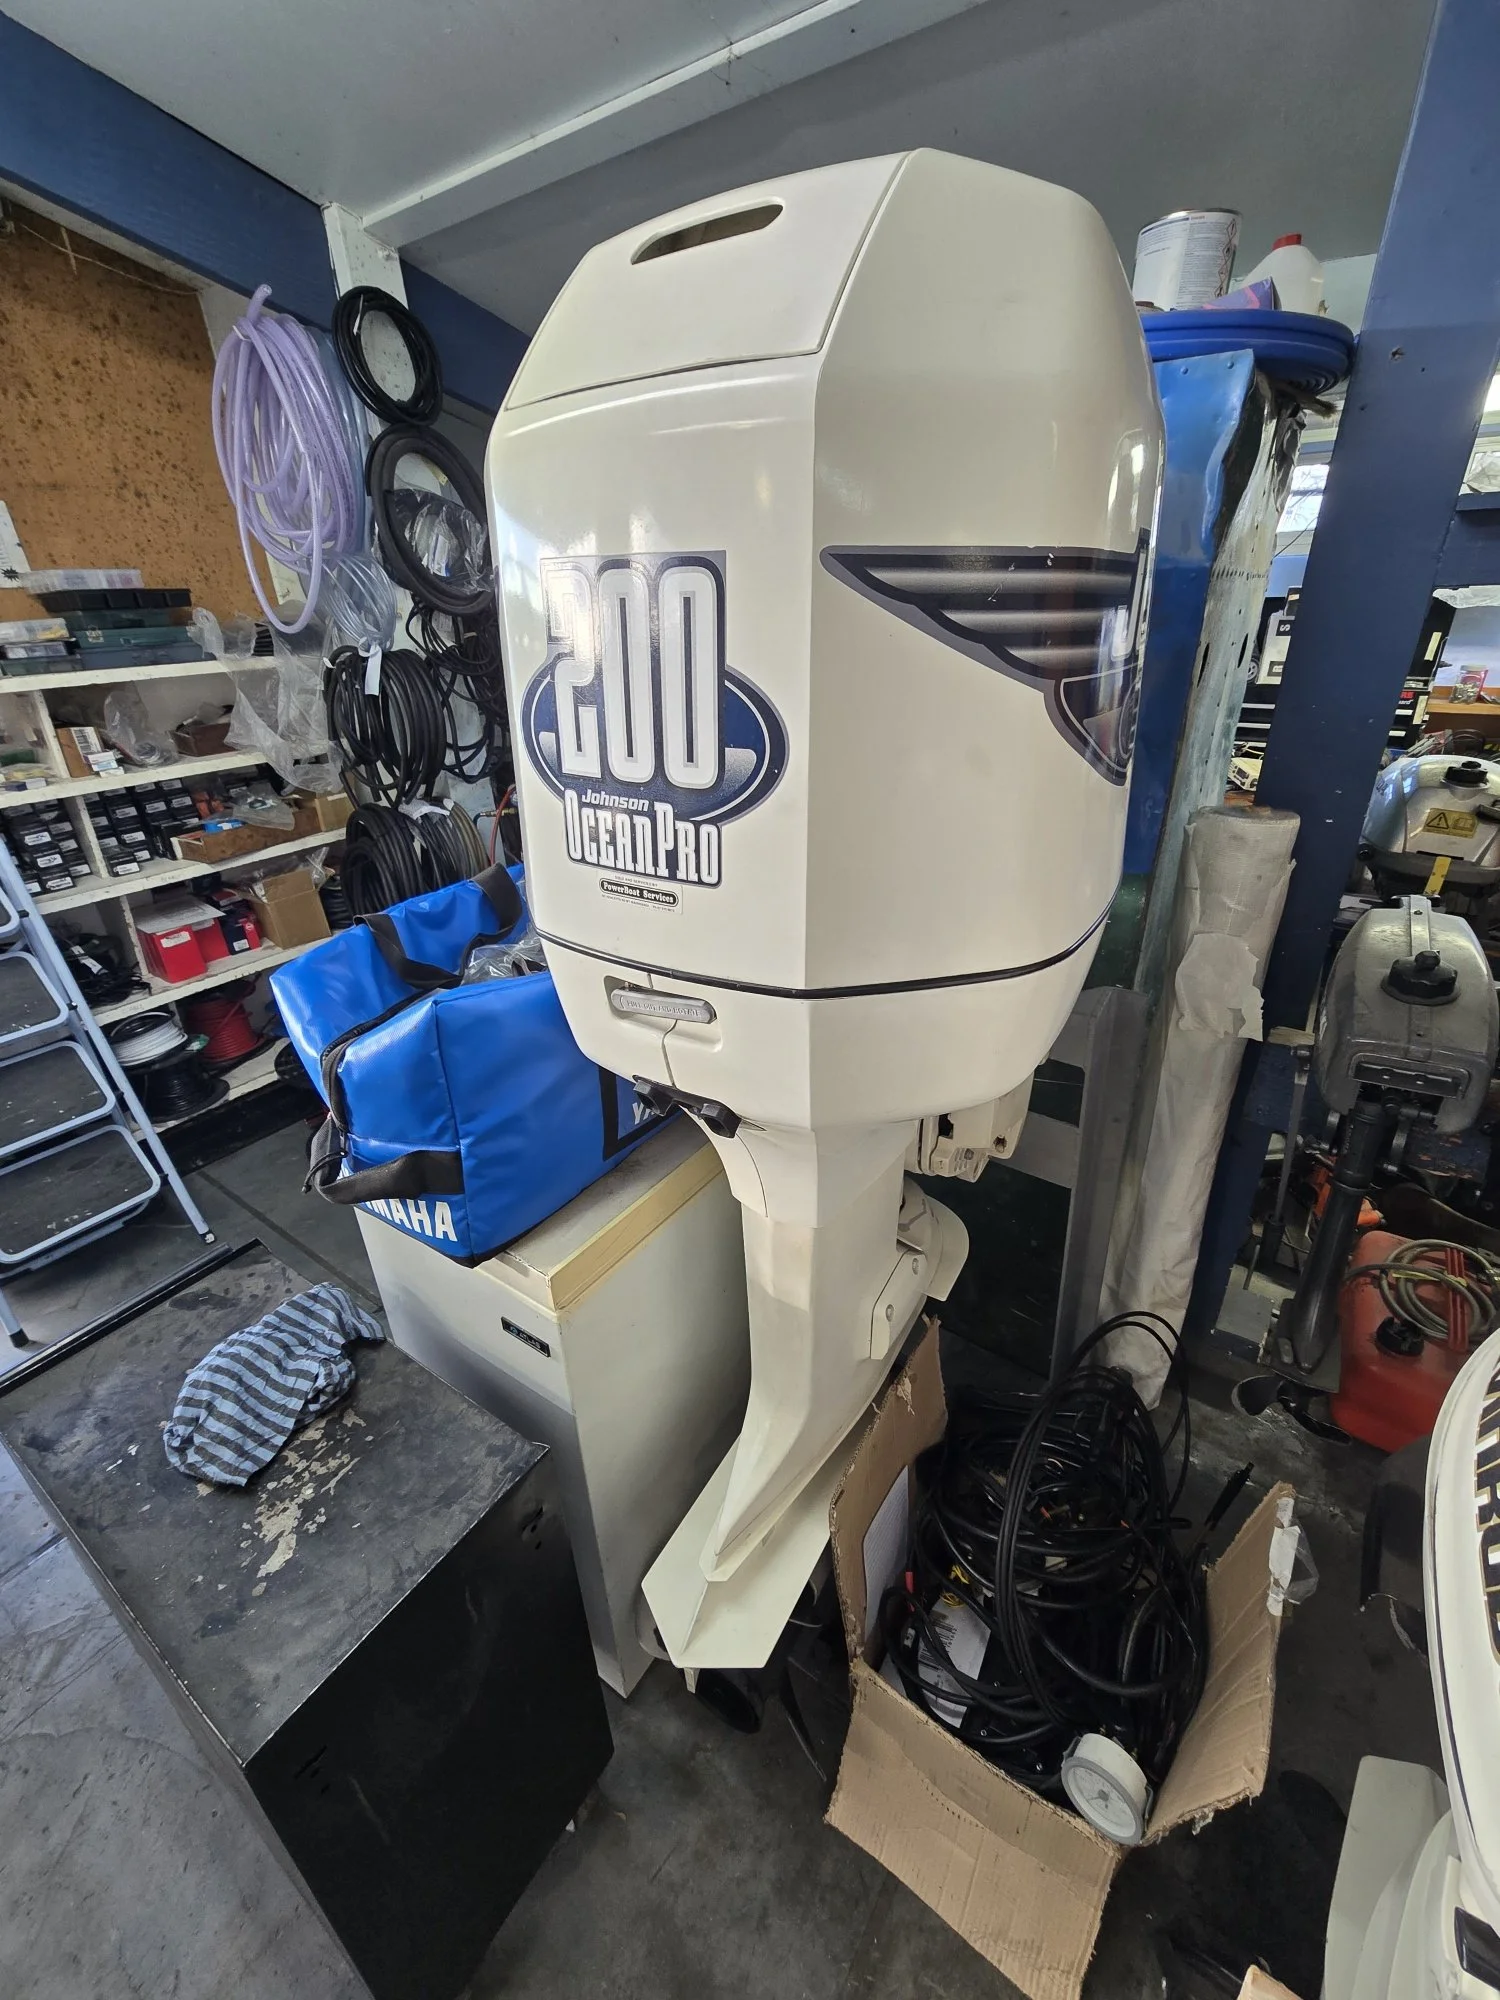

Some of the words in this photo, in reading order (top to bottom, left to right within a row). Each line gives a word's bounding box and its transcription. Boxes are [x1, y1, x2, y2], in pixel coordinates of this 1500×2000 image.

[543, 560, 719, 790] 200
[581, 788, 649, 812] Johnson
[602, 881, 641, 897] PowerBoat
[642, 890, 674, 904] Services
[364, 1198, 458, 1242] MAHA
